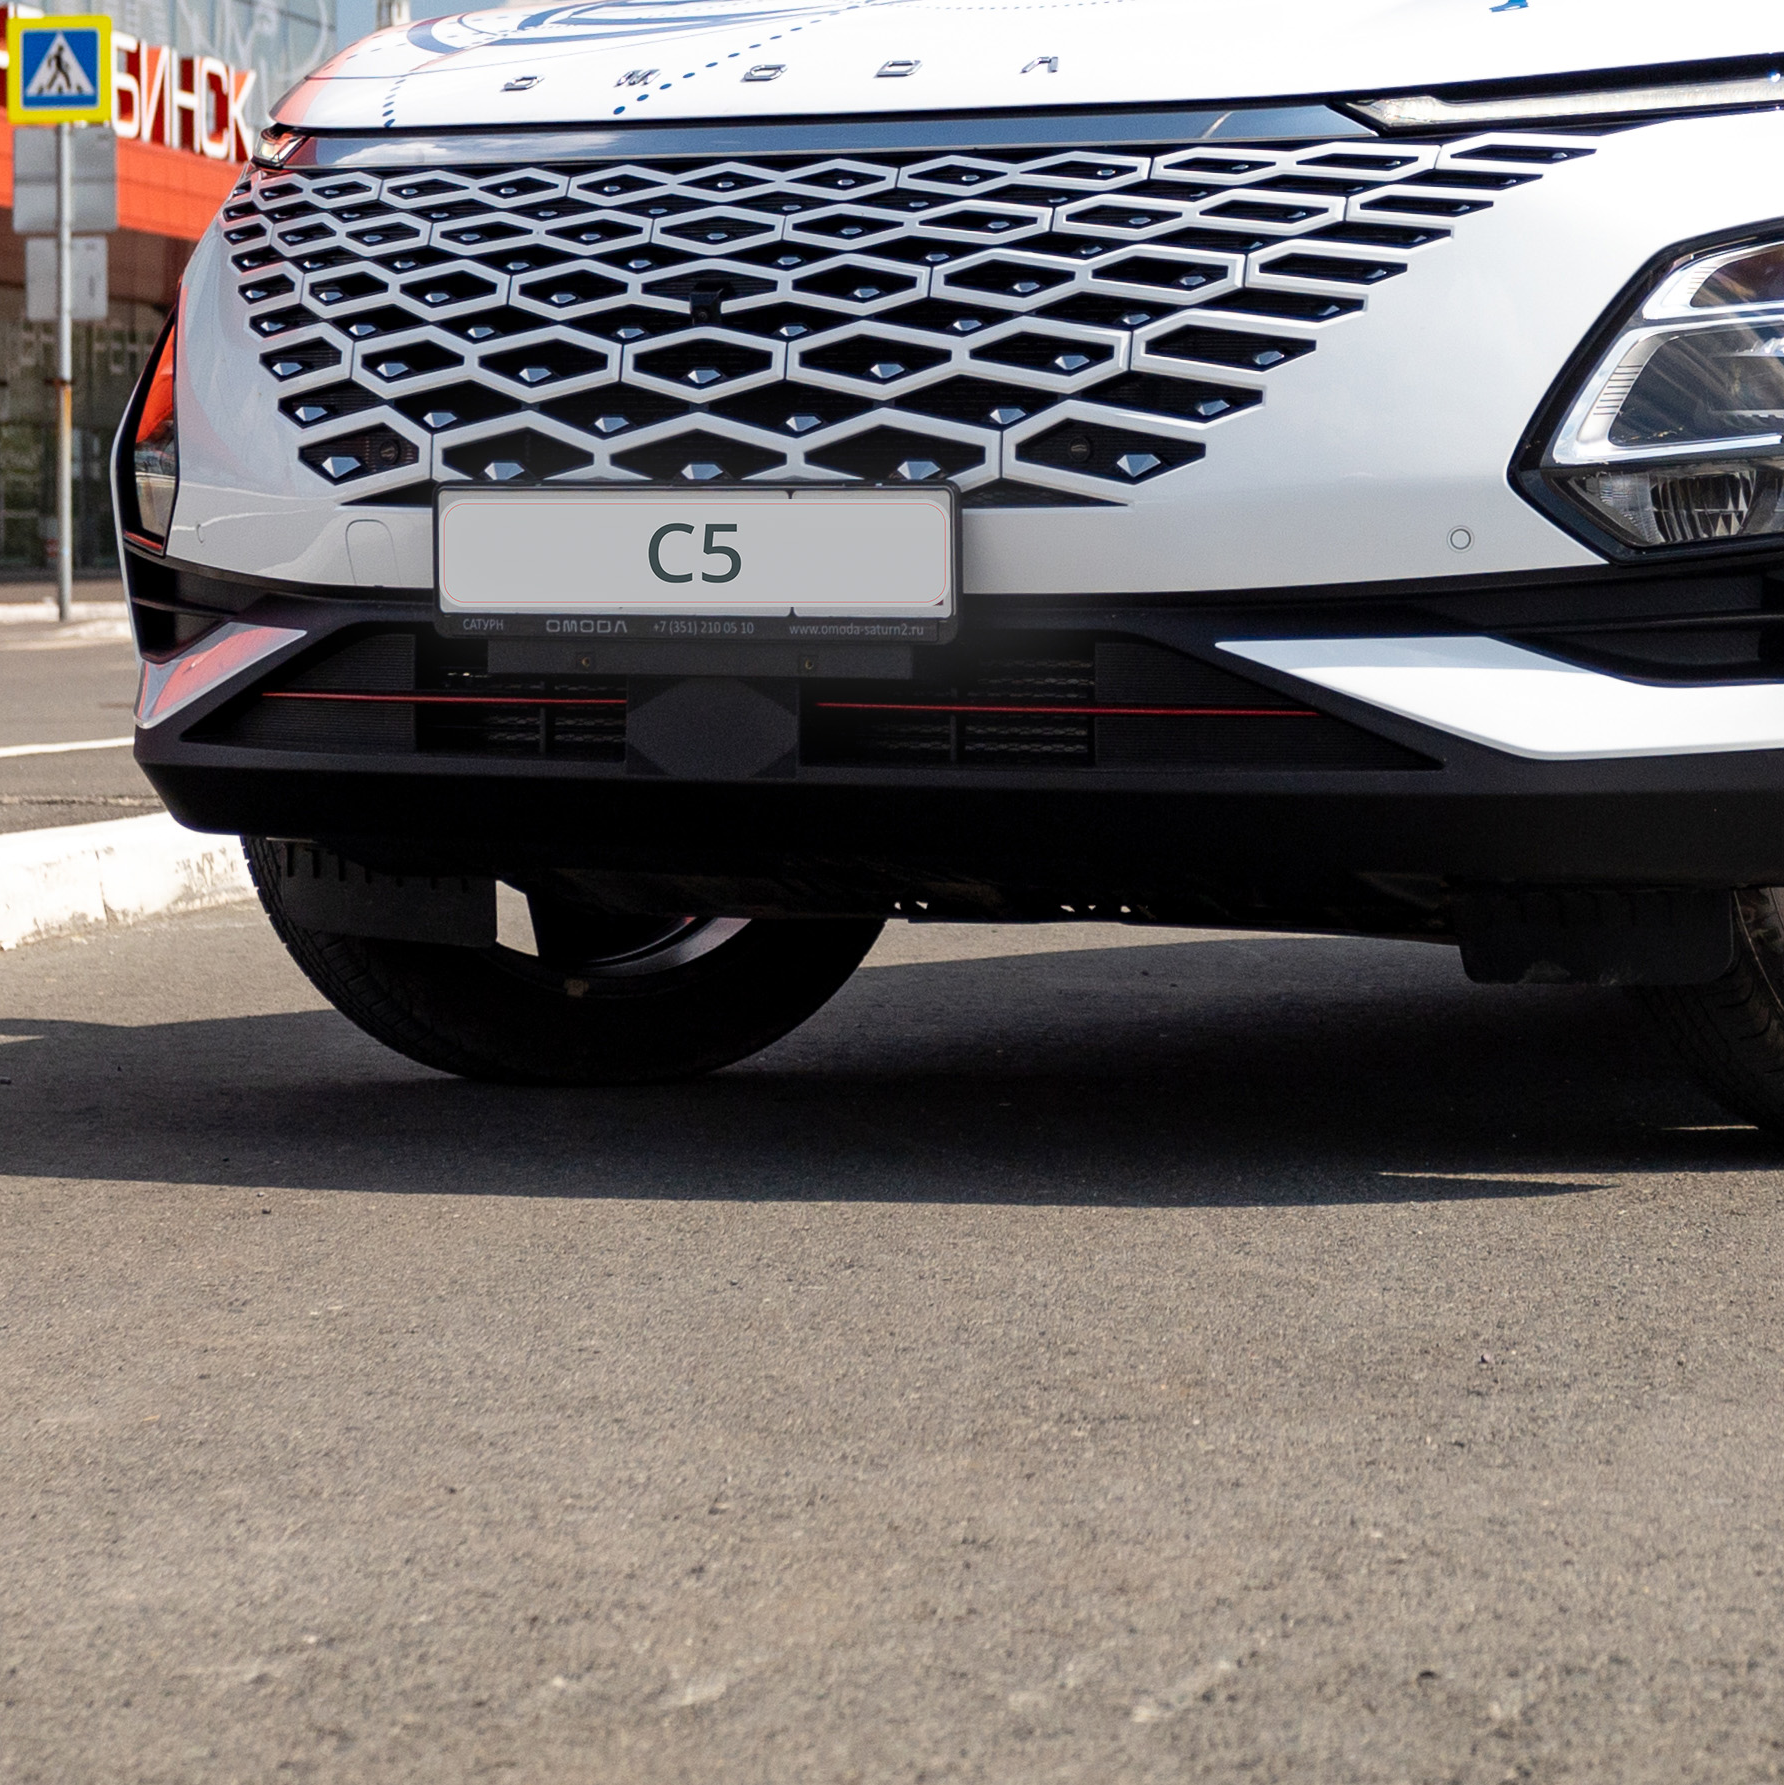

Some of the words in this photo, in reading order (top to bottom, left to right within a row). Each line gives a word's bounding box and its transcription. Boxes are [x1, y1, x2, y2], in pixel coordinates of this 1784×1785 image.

[501, 54, 1060, 92] OMODA
[646, 521, 743, 584] C5
[462, 618, 504, 632] САТУРН
[546, 619, 628, 634] OMODA
[652, 621, 667, 634] +7
[669, 619, 697, 636] (351)
[699, 620, 720, 634] 210
[722, 620, 738, 634] 05
[740, 620, 755, 635] 10
[789, 620, 925, 638] www.omoda-saturn2.ru
